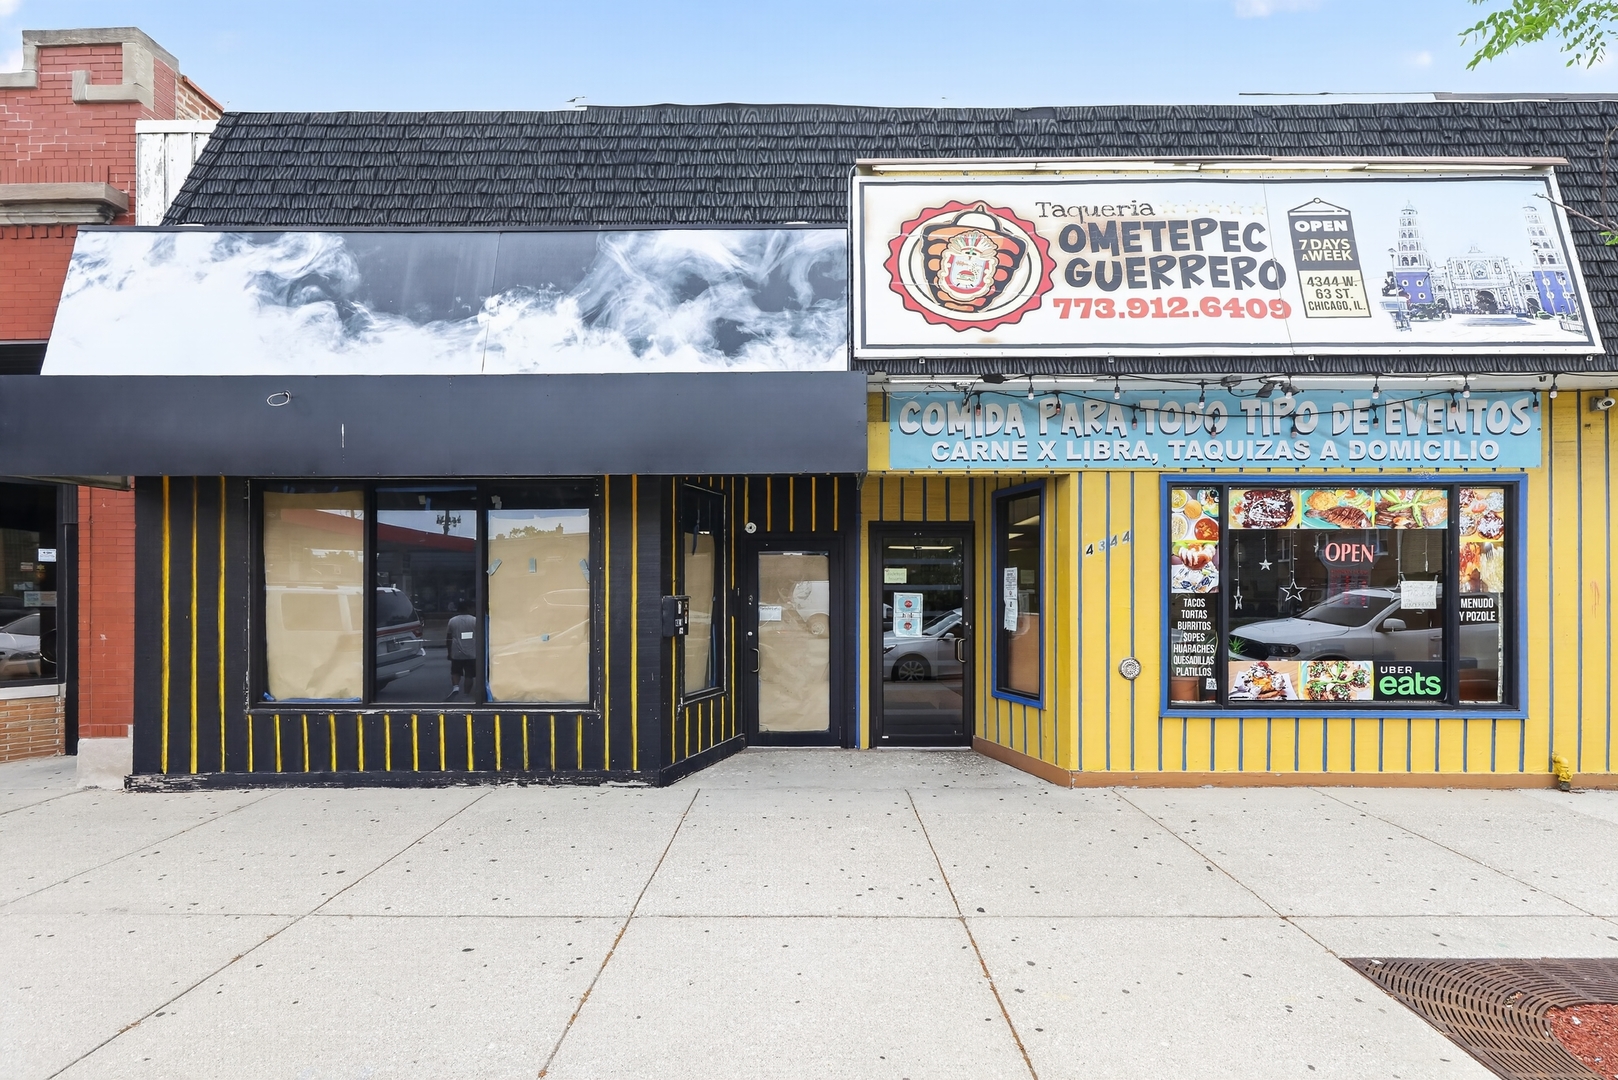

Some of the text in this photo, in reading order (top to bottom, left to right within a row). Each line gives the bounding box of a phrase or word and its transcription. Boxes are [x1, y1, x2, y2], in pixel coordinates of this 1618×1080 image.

[1035, 200, 1156, 224] Taqueria
[1294, 220, 1348, 232] OPEN
[1058, 217, 1268, 257] OMETEPEC
[1298, 238, 1351, 250] 7 DAYS
[1064, 254, 1287, 292] GUERRERO
[1306, 276, 1358, 287] 4344 W.
[1315, 288, 1354, 299] 63 ST.
[1053, 296, 1292, 320] 773.912.6409
[1308, 300, 1366, 311] CHICAGO, IL.
[898, 397, 1532, 439] COMIDA PARA TODO TIPO DE EVENTOS
[931, 440, 1500, 465] CARNE X LIBRA, TAQUIZAS A DOMICILIO
[1325, 542, 1375, 563] OPEN
[1183, 598, 1206, 607] TACOS
[1460, 598, 1494, 608] MENUDO
[1181, 609, 1208, 619] TORTAS
[1459, 611, 1496, 621] Y POZOLE
[1177, 621, 1212, 631] BURRITOS
[1183, 632, 1206, 642] SOPES
[1173, 644, 1215, 653] HUARACHES
[1173, 655, 1215, 665] QUESADILLAS
[1176, 667, 1212, 676] PLATILLOS
[1380, 665, 1413, 674] UBER
[1379, 671, 1442, 696] eats
